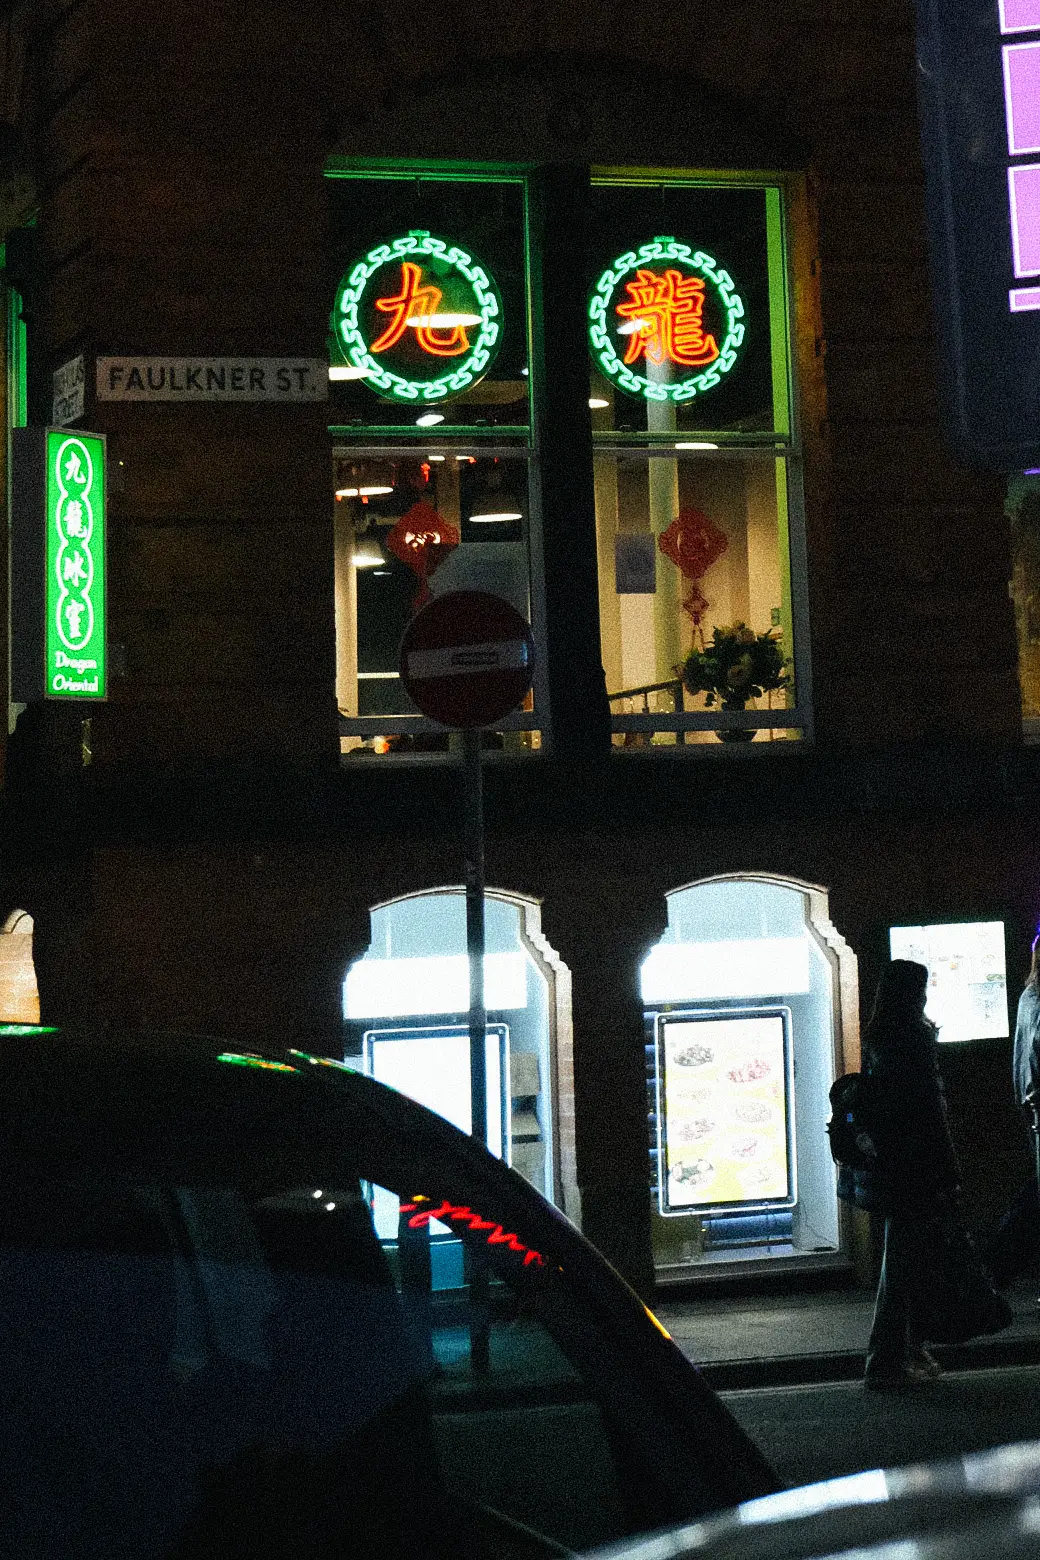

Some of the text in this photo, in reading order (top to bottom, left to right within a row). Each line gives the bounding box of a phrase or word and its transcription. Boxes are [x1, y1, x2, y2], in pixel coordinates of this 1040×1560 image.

[108, 366, 267, 391] FAULKNER
[276, 366, 317, 393] ST.
[54, 649, 98, 675] Dragon
